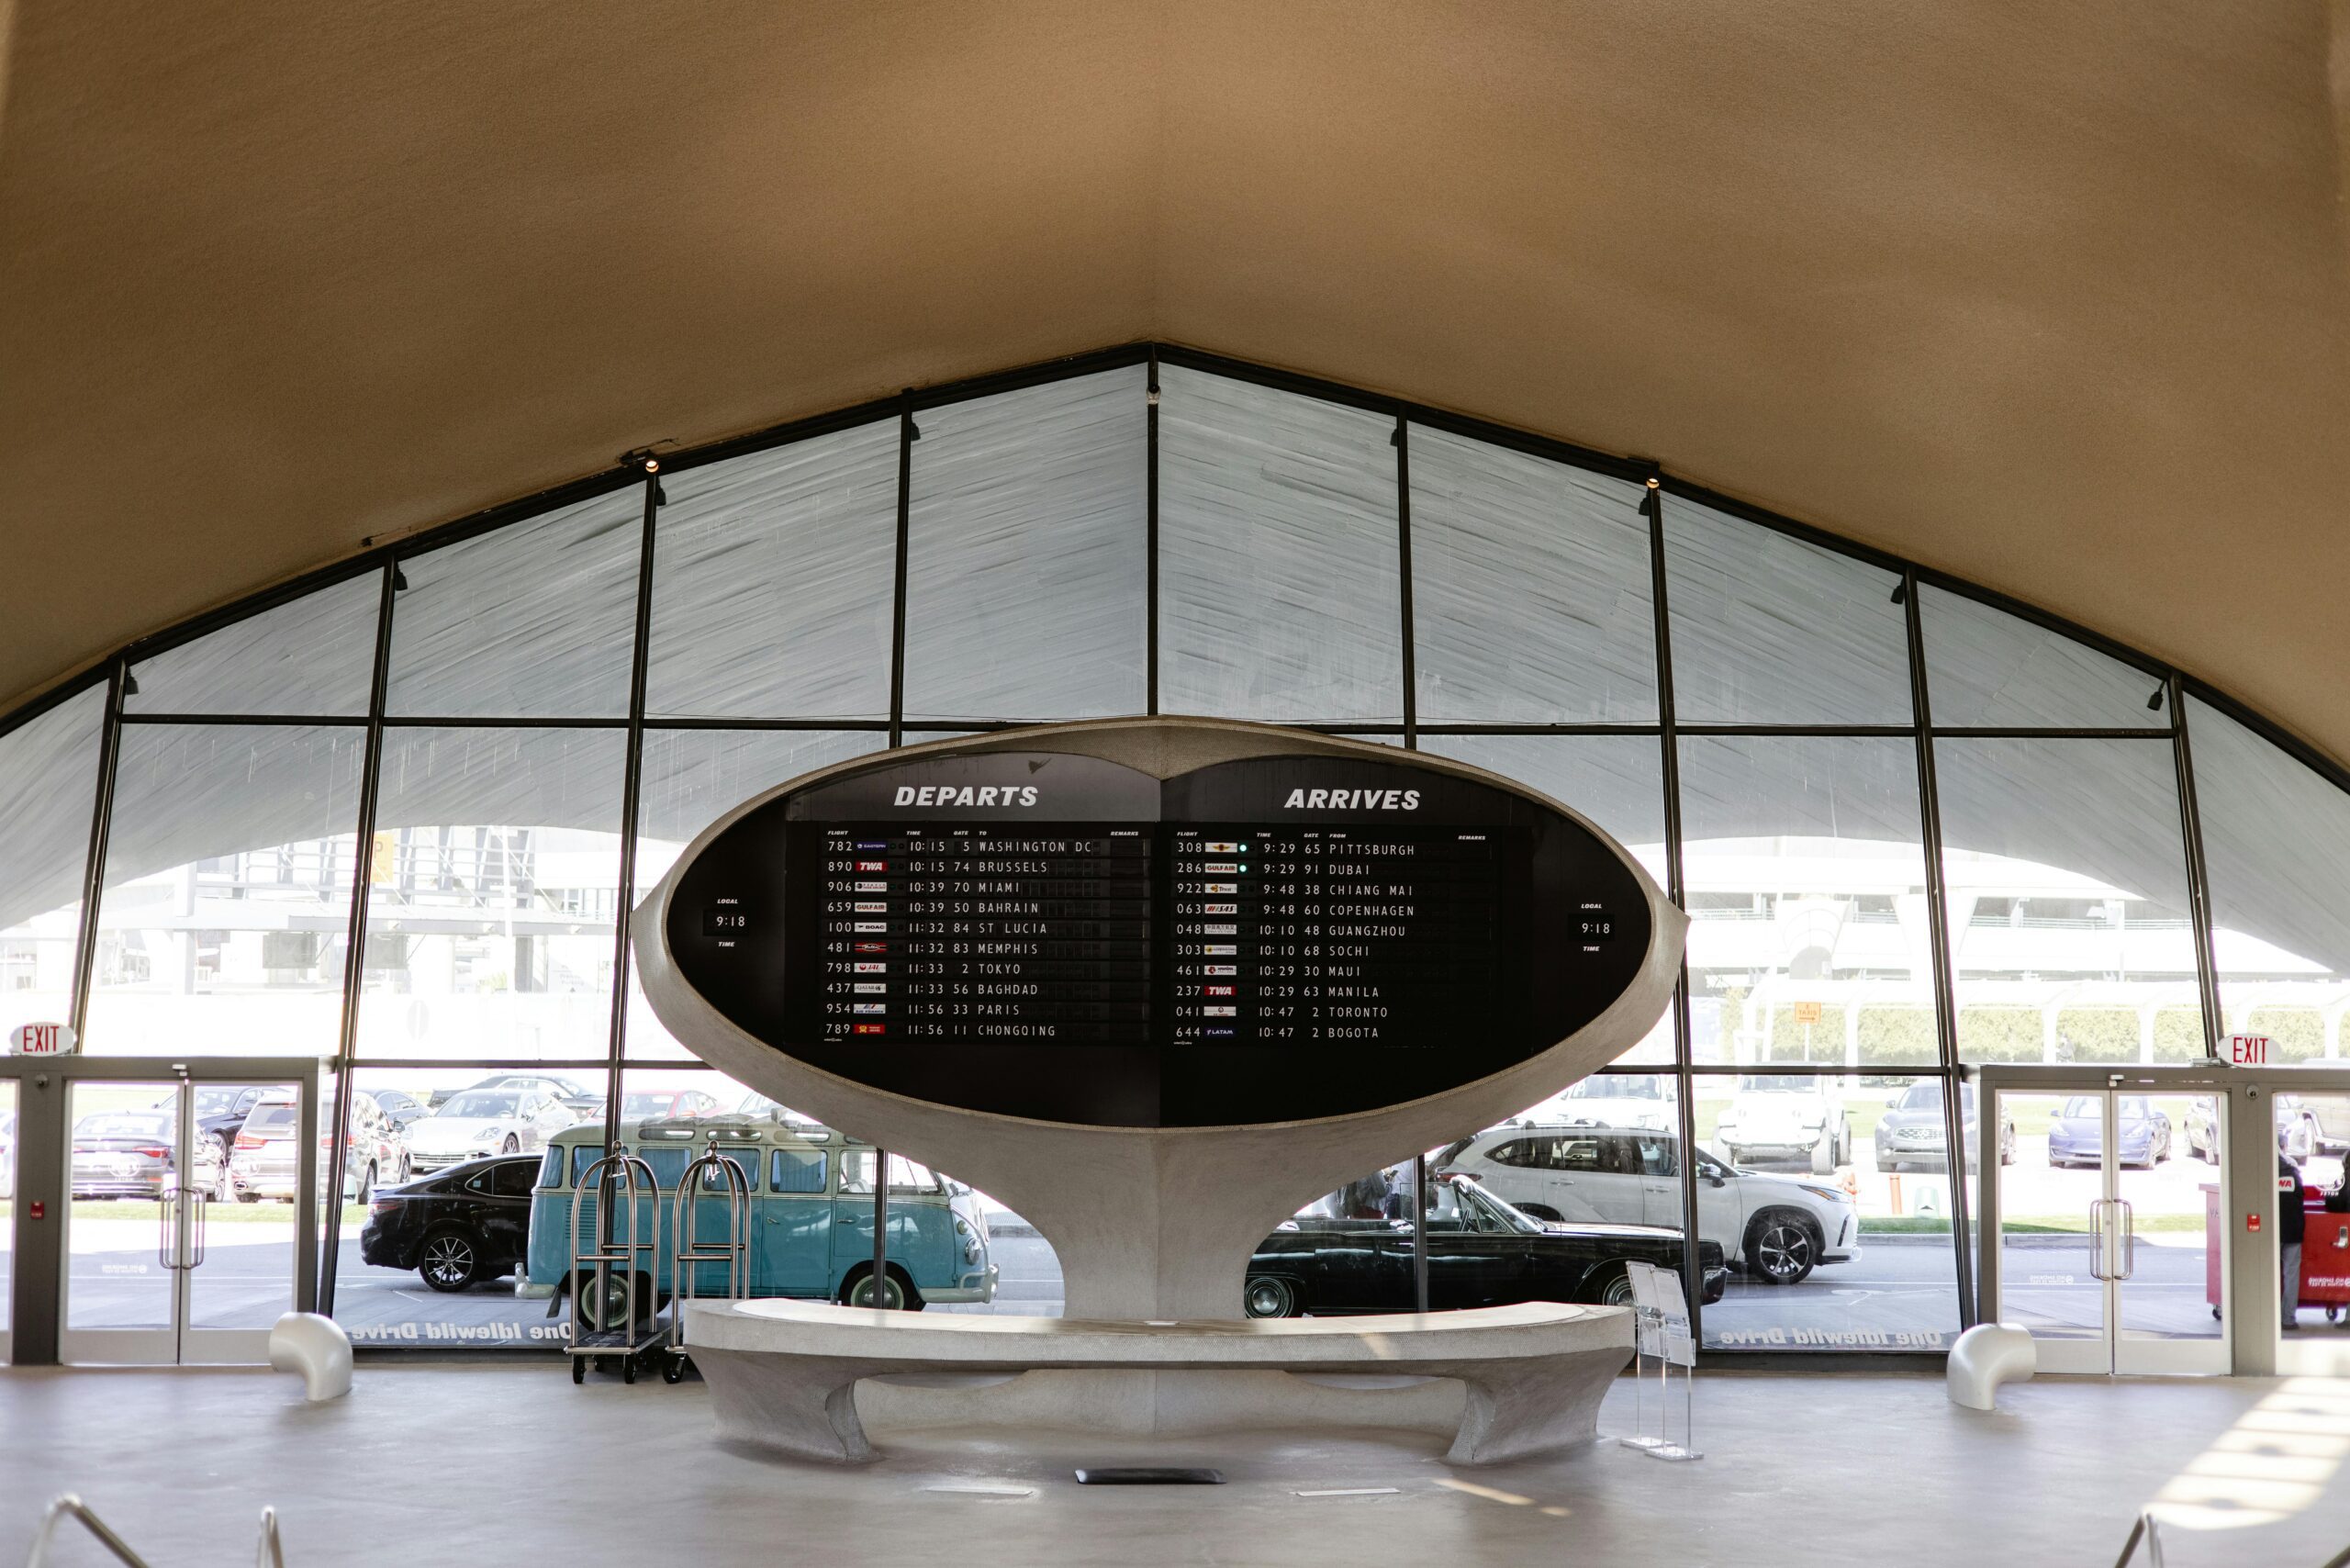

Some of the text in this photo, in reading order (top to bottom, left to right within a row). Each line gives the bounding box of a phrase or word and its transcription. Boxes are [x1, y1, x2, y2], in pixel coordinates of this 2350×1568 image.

[893, 785, 1039, 807] DEPARTS
[1283, 788, 1421, 811] ARRIVES
[828, 840, 853, 852] 782
[963, 841, 970, 852] 5
[979, 841, 1065, 852] WASHINGTON
[1075, 841, 1091, 853] DC
[1178, 842, 1203, 853] 308
[1304, 844, 1320, 855] 65
[1329, 844, 1415, 856] PITTSBURGH
[828, 861, 853, 872] 890
[859, 862, 883, 870] TWA
[954, 861, 970, 872] 74
[979, 861, 1047, 873] BRUSSELS
[1177, 862, 1202, 873] 286
[1304, 864, 1318, 875] 91
[1329, 864, 1369, 876] DUBAI
[827, 880, 852, 892] 906
[954, 881, 970, 892] 70
[979, 881, 1019, 893] MIAMI
[1177, 882, 1202, 894] 922
[1304, 884, 1320, 895] 38
[1329, 884, 1380, 896] CHIANG
[1389, 885, 1412, 896] MAI
[827, 902, 852, 913] 659
[954, 902, 969, 913] 50
[979, 902, 1038, 913] BAHRAIN
[1177, 903, 1202, 914] 063
[1304, 904, 1320, 915] 60
[1329, 904, 1414, 916] COPENHAGEN
[716, 915, 745, 927] 9:18
[829, 922, 852, 933] 100
[953, 922, 969, 934] 84
[979, 923, 994, 934] ST
[1004, 923, 1046, 934] LUCIA
[1177, 924, 1202, 935] 048
[1304, 924, 1320, 935] 48
[1328, 924, 1405, 936] GUANGZHOU
[1582, 923, 1610, 935] 9:18
[827, 942, 850, 953] 481
[953, 943, 968, 954] 83
[978, 943, 1037, 955] MEMPHIS
[1177, 944, 1201, 956] 303
[1304, 945, 1320, 957] 68
[1329, 946, 1369, 957] SOCHI
[827, 962, 851, 973] 798
[962, 963, 968, 974] 2
[979, 963, 1021, 975] TOKYO
[1177, 965, 1200, 976] 461
[1304, 966, 1320, 977] 30
[1328, 966, 1360, 977] MAUI
[826, 982, 851, 993] 437
[953, 983, 968, 995] 56
[978, 983, 1038, 995] BAGHDAD
[1176, 985, 1201, 996] 237
[1209, 986, 1232, 995] TWA
[1304, 986, 1319, 997] 63
[1328, 986, 1379, 998] MANILA
[826, 1002, 851, 1014] 954
[953, 1003, 968, 1015] 33
[978, 1004, 1019, 1015] PARIS
[1176, 1006, 1199, 1017] 041
[1312, 1006, 1319, 1017] 2
[1328, 1006, 1388, 1018] TORONTO
[826, 1024, 850, 1035] 789
[955, 1025, 967, 1036] 11
[1176, 1026, 1201, 1037] 644
[1312, 1027, 1319, 1038] 2
[1328, 1027, 1379, 1038] BOGOTA
[23, 1025, 60, 1052] EXIT
[2232, 1037, 2269, 1063] EXIT
